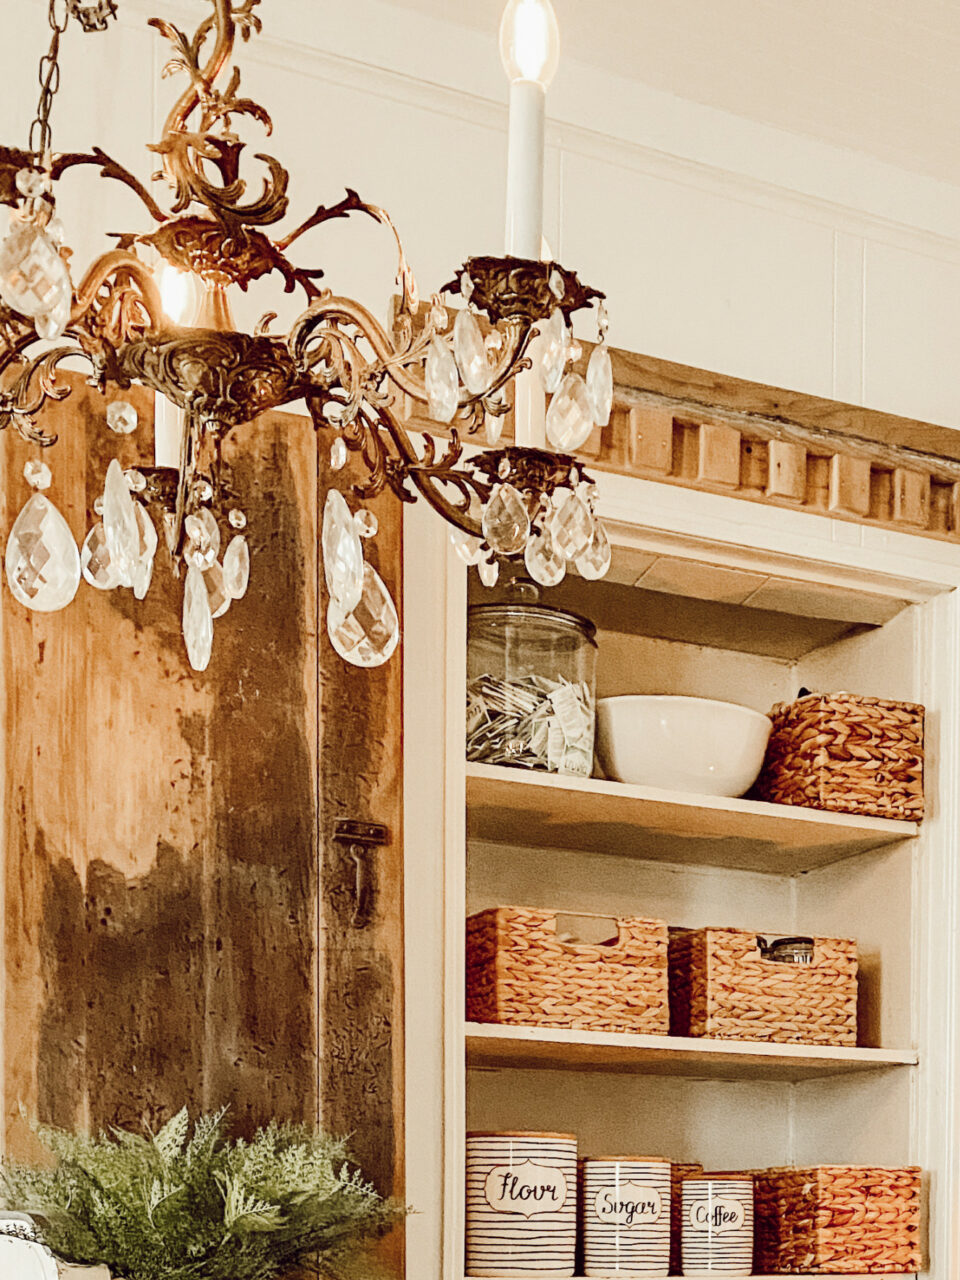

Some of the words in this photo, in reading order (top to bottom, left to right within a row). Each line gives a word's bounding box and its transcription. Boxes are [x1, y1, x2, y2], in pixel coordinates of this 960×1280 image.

[498, 1172, 558, 1201] Flour
[601, 1193, 657, 1224] Sugar
[696, 1205, 738, 1226] Coffee
